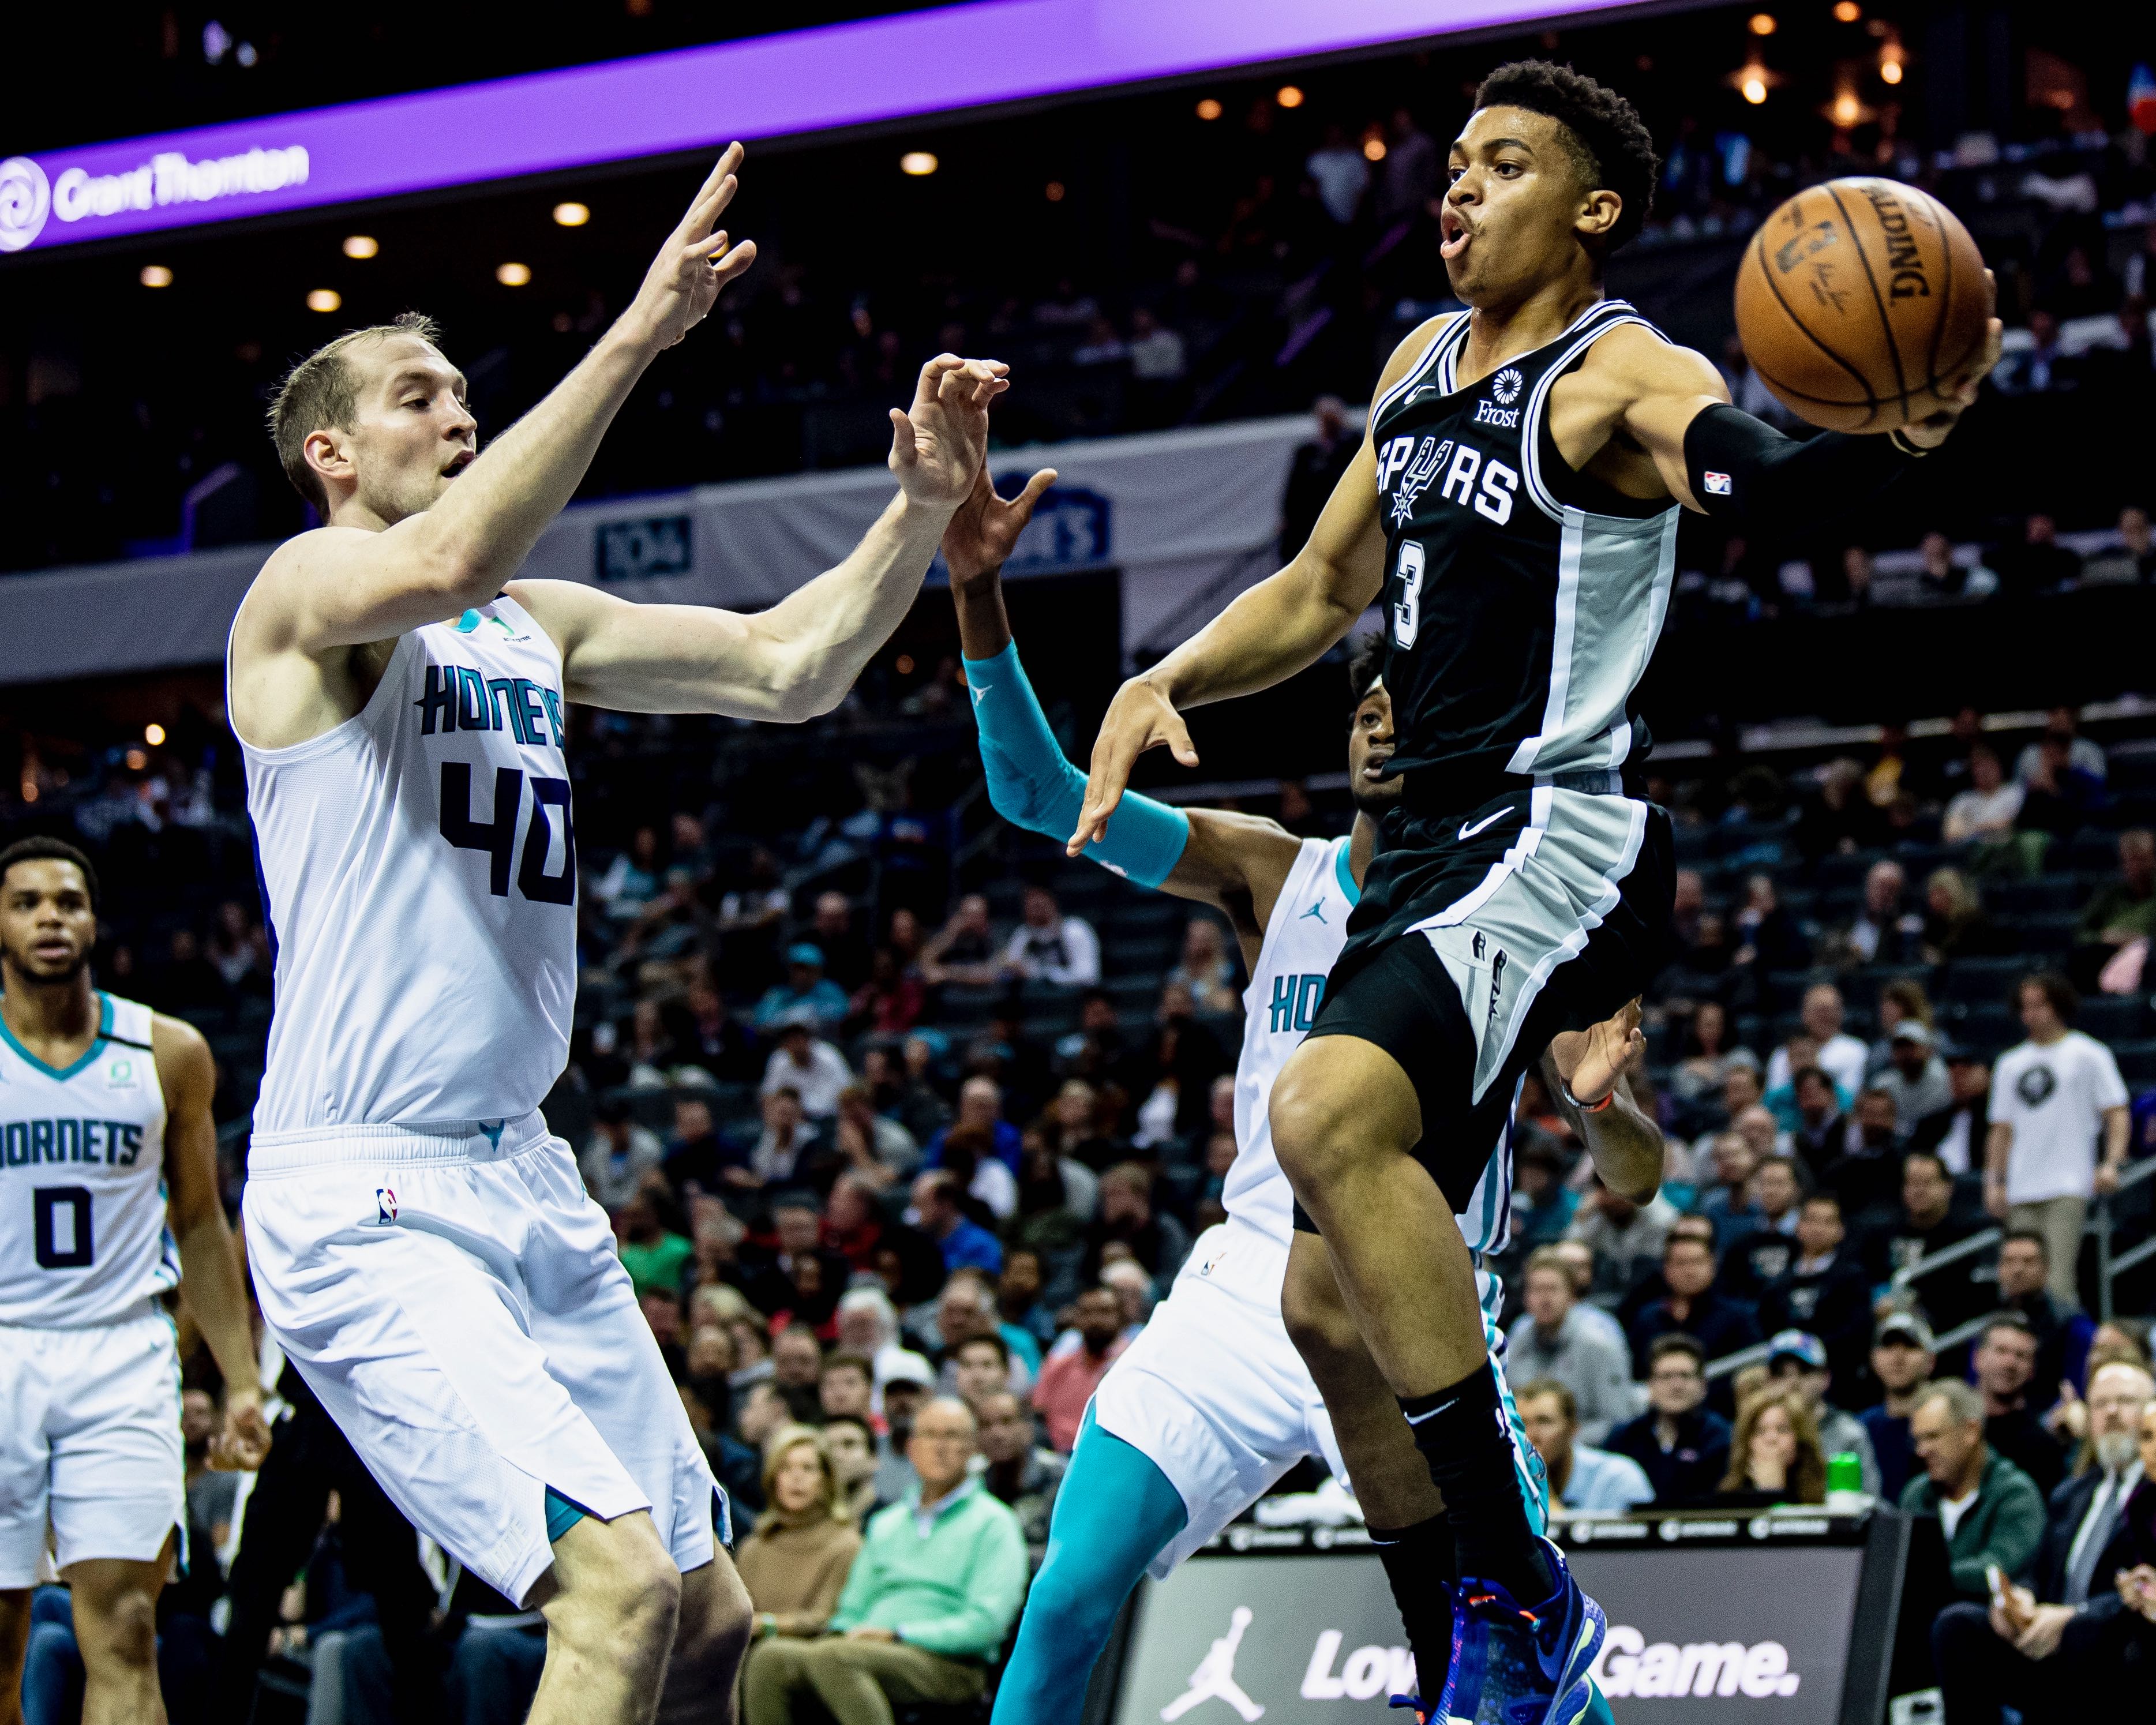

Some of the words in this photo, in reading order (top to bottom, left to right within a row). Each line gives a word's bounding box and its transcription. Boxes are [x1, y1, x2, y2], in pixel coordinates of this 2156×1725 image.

[53, 164, 153, 223] Grant
[153, 145, 310, 206] Thornton
[1473, 399, 1520, 428] Frost
[1376, 436, 1518, 527] SPURS
[1394, 539, 1425, 650] 3
[439, 761, 576, 906] 40
[0, 1118, 143, 1168] ORNETS
[34, 1186, 93, 1268] 0
[1585, 1625, 1800, 1698] Game.
